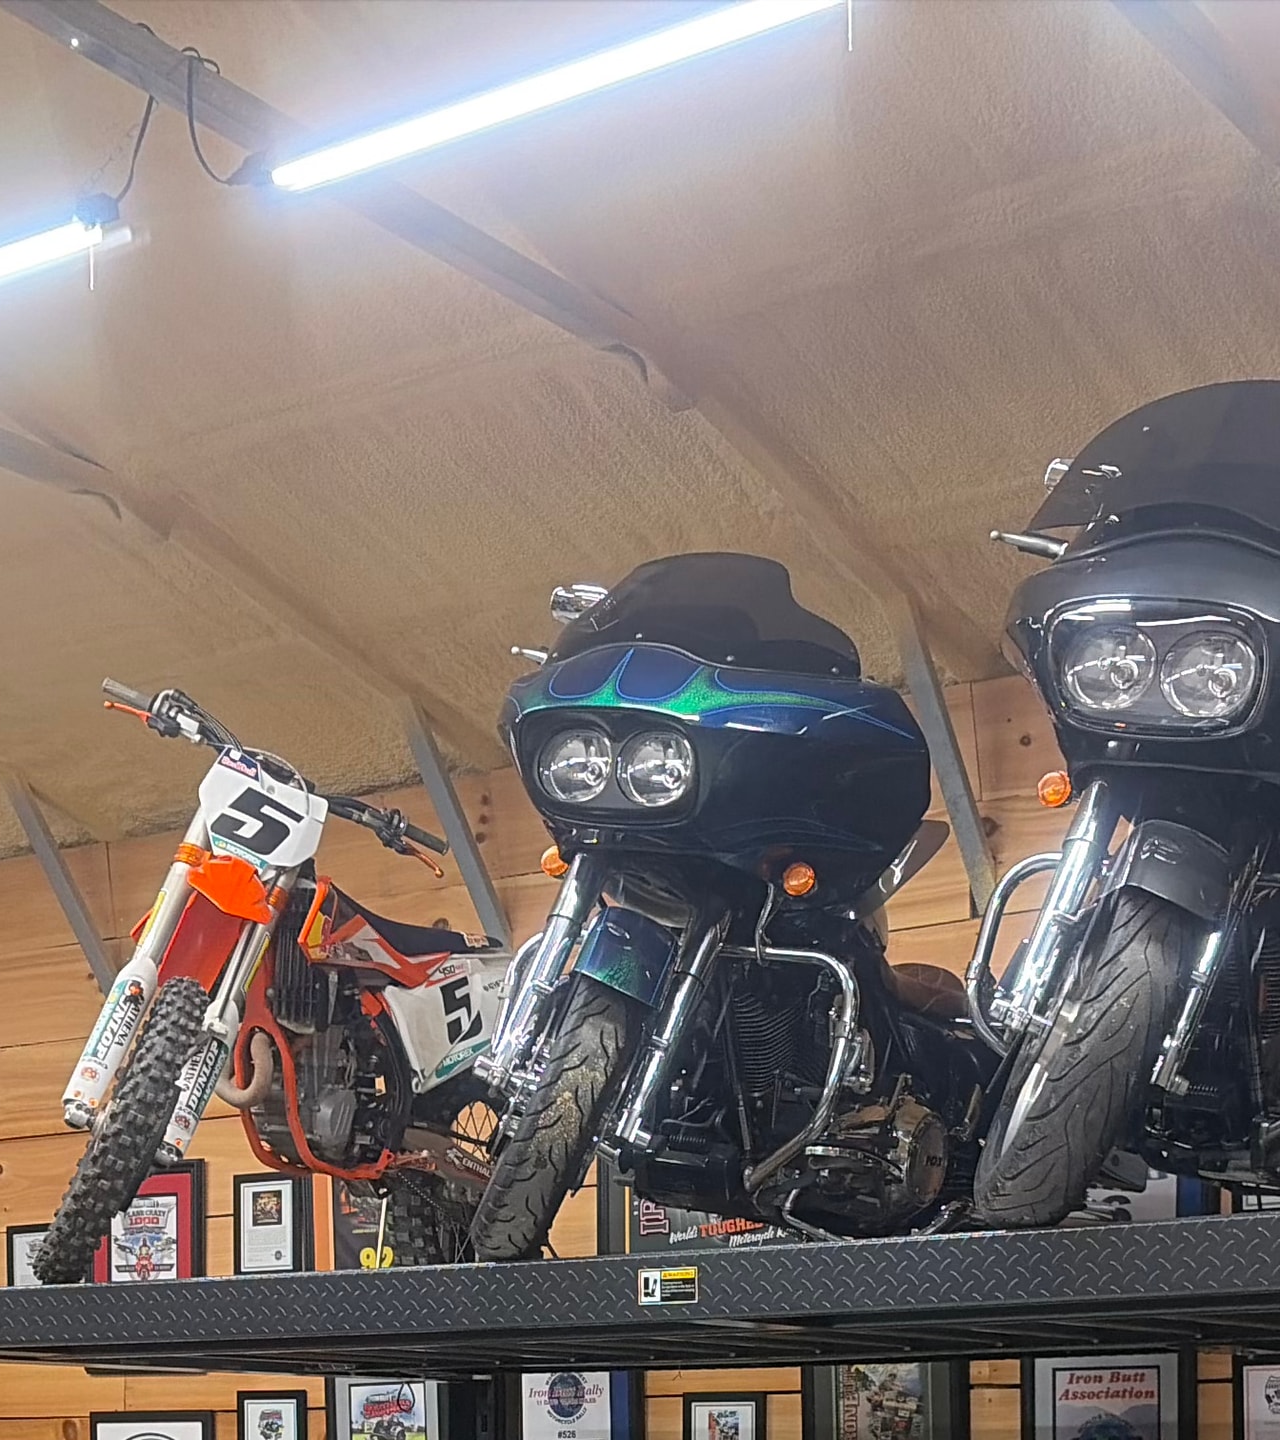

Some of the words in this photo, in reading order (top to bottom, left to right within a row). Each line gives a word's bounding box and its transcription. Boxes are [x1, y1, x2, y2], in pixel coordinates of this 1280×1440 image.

[210, 787, 305, 856] 5
[440, 976, 483, 1046] 5
[442, 1049, 474, 1066] MOTOREX
[188, 1040, 219, 1111] DUNLOP
[729, 1226, 774, 1248] Motorcycle
[1067, 1373, 1103, 1385] Iron
[1109, 1371, 1147, 1384] Butt
[1059, 1386, 1156, 1401] Association
